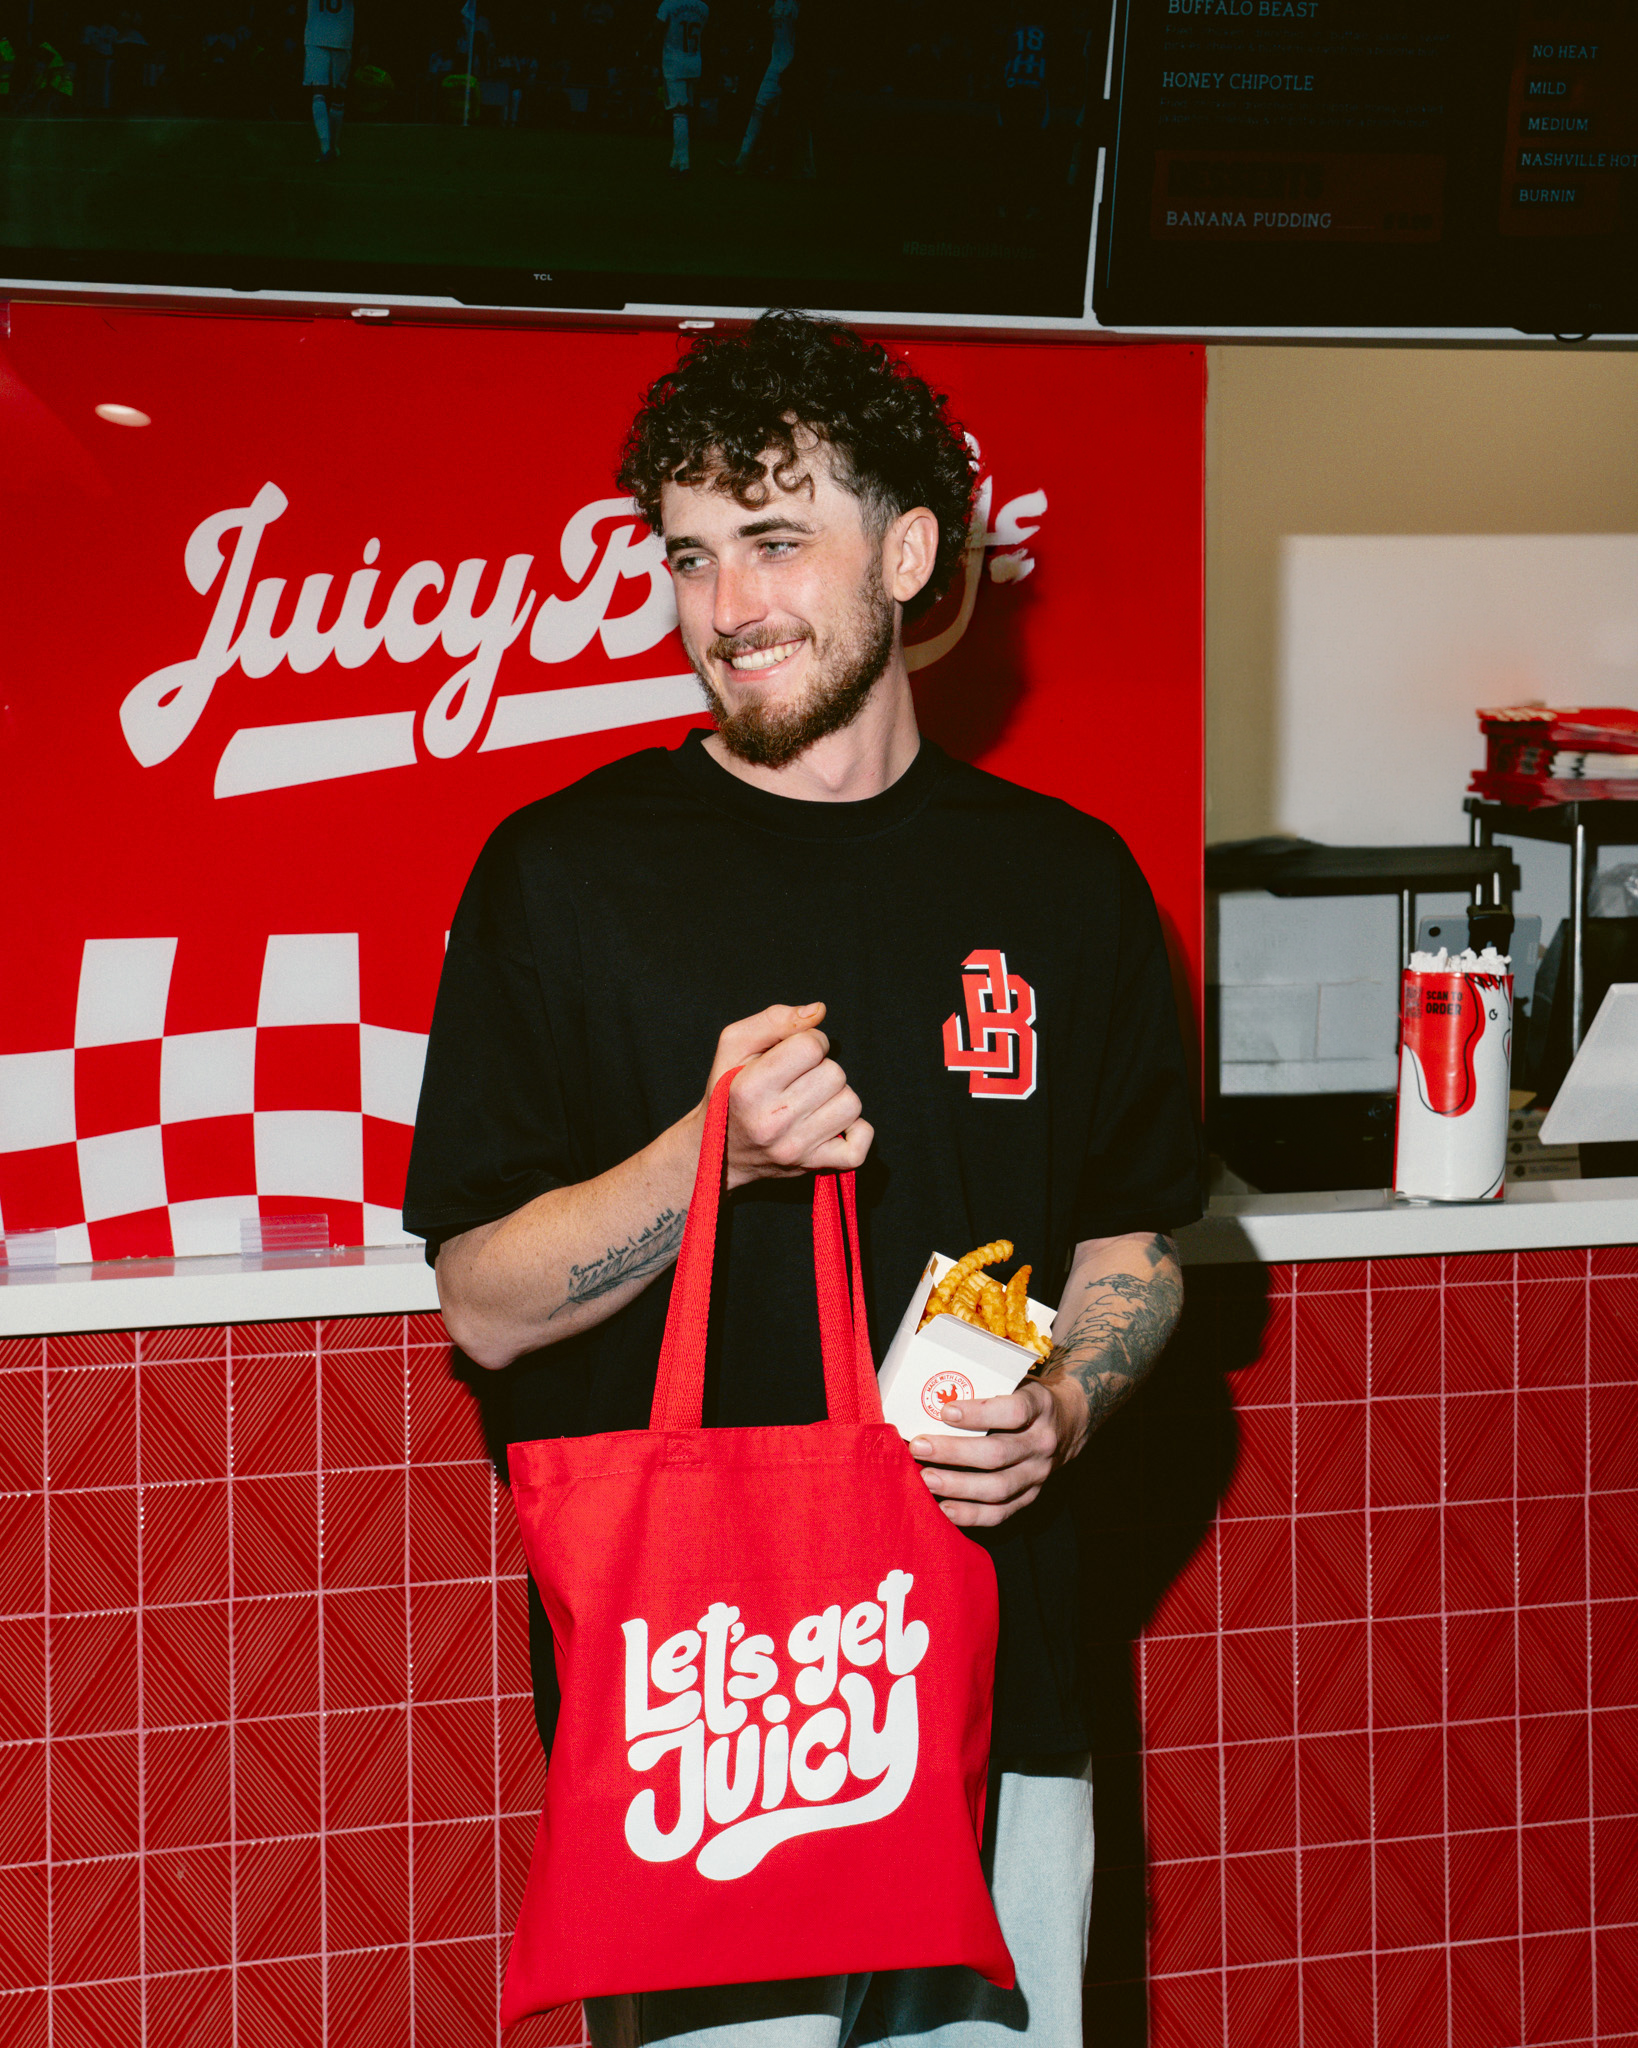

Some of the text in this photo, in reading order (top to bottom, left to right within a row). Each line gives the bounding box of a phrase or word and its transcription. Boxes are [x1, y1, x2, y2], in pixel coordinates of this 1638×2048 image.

[1167, 0, 1319, 18] BUFFALO BEAST
[1014, 27, 1045, 51] 18
[1532, 45, 1599, 59] NO HEAT
[1161, 71, 1315, 91] HONEY CHIPOTLE
[1529, 81, 1567, 95] MILD
[1527, 117, 1589, 131] MEDIUM
[1520, 153, 1638, 168] NASHVILLE HOT
[1518, 189, 1576, 203] BURNIN
[1165, 210, 1332, 229] BANANA PUDDING
[533, 273, 553, 281] TCL
[1426, 991, 1463, 1001] SCAN TO
[1425, 1003, 1462, 1015] ORDER
[954, 1376, 968, 1388] LOVE
[622, 1569, 930, 1741] Let's get
[624, 1672, 918, 1881] Juicy
